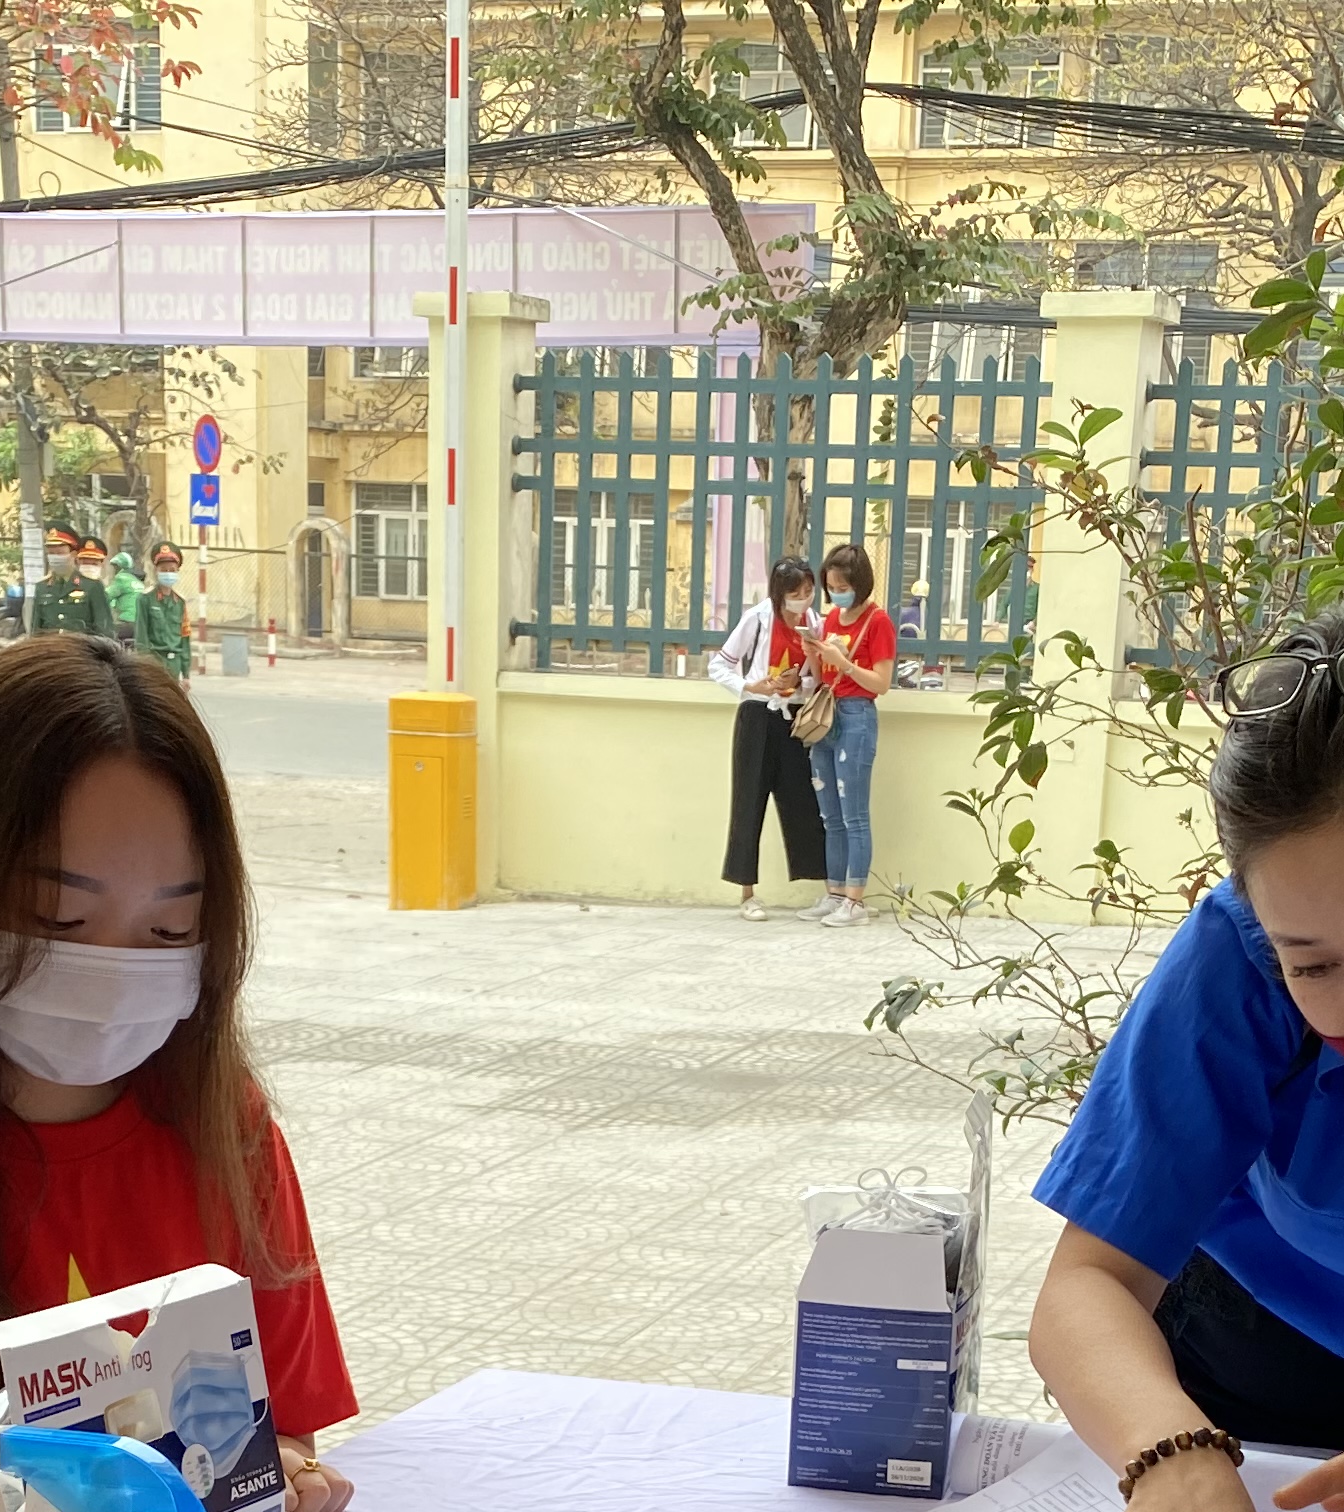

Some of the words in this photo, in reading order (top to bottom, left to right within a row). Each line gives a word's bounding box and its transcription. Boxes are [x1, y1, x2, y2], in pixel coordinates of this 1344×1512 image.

[18, 1357, 93, 1409] MASK
[94, 1355, 122, 1384] Anti
[230, 1470, 278, 1502] ASANTE
